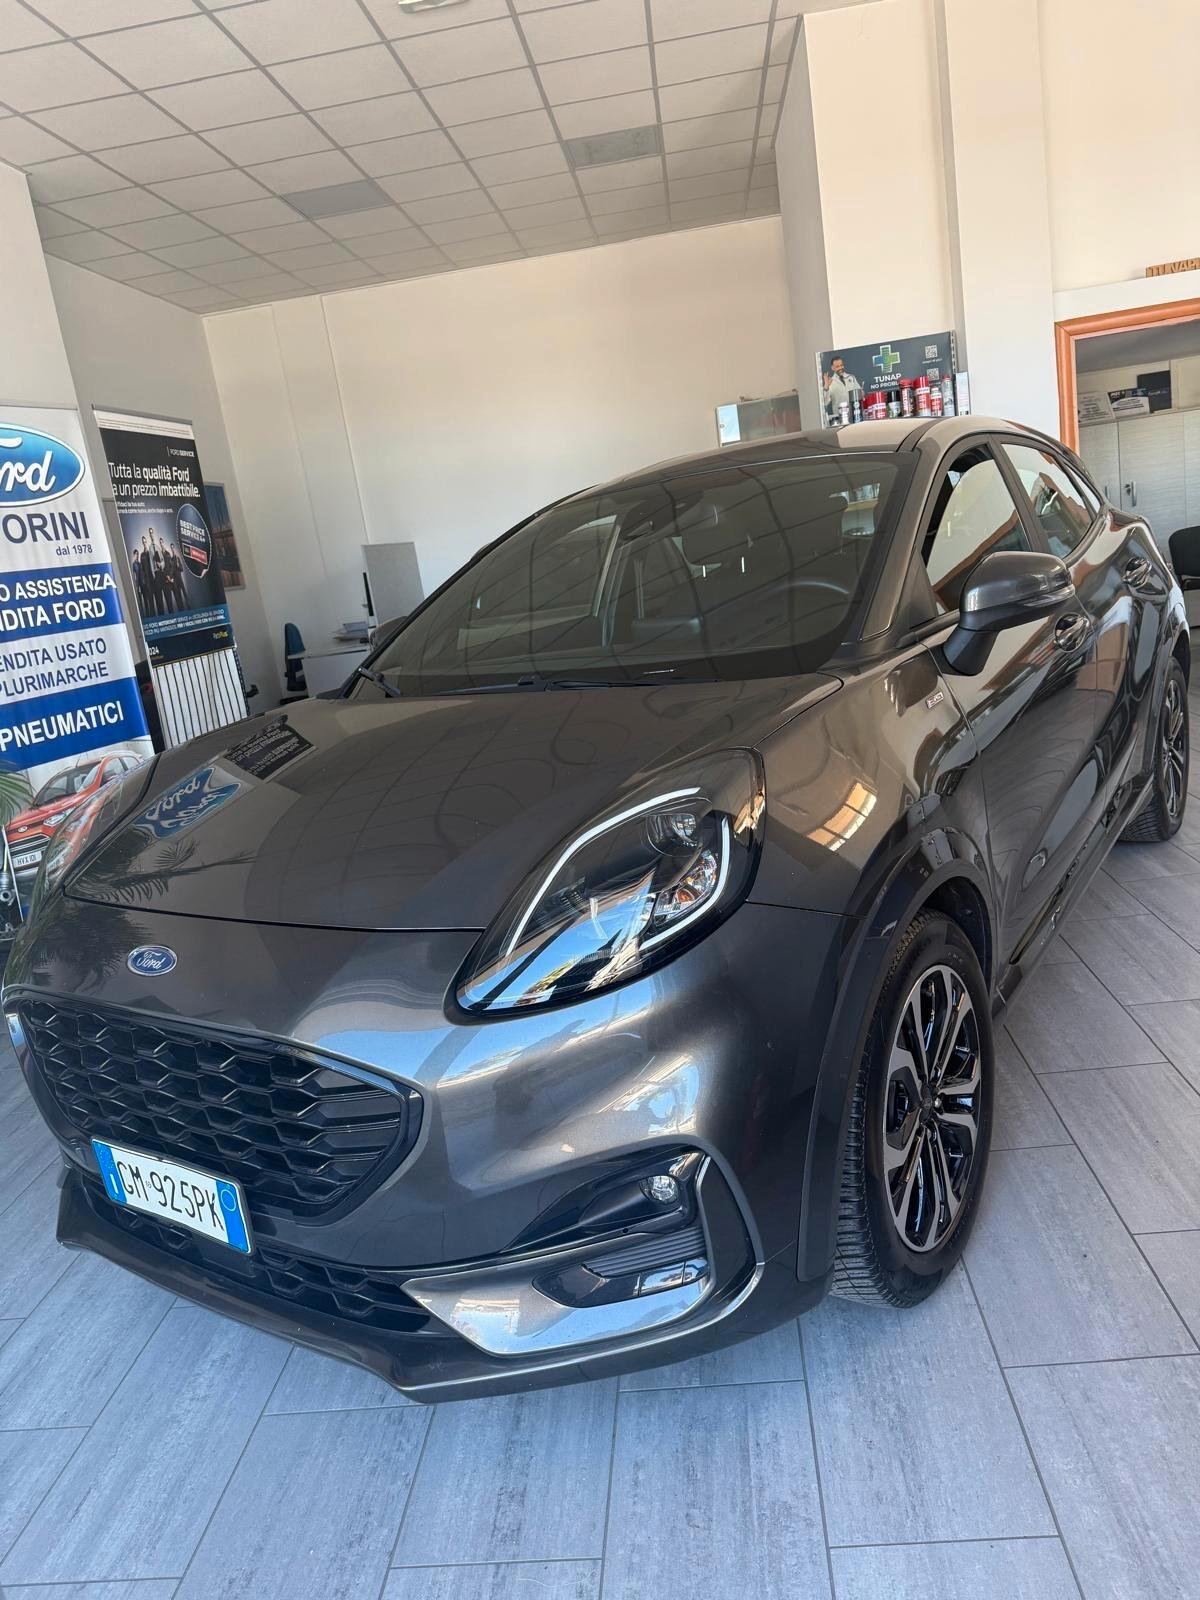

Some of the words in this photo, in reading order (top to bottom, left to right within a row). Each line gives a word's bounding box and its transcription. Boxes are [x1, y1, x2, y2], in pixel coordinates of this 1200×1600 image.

[870, 383, 880, 391] NO
[874, 373, 902, 383] TUNAP
[0, 437, 57, 492] rd
[108, 462, 132, 478] Tutta
[133, 463, 142, 479] la
[142, 465, 172, 482] qualità
[172, 467, 190, 482] Ford
[119, 483, 131, 496] un
[132, 484, 158, 498] prezzo
[158, 482, 201, 498] imbattibile.
[2, 511, 90, 544] ORINI
[56, 545, 70, 556] dal
[73, 544, 93, 555] 1978
[15, 573, 117, 600] ASSISTENZA
[52, 598, 106, 624] FORD
[55, 638, 107, 661] USATO
[0, 701, 124, 752] PNEUMATICI
[136, 950, 166, 970] Ford
[150, 1171, 225, 1232] 925PK
